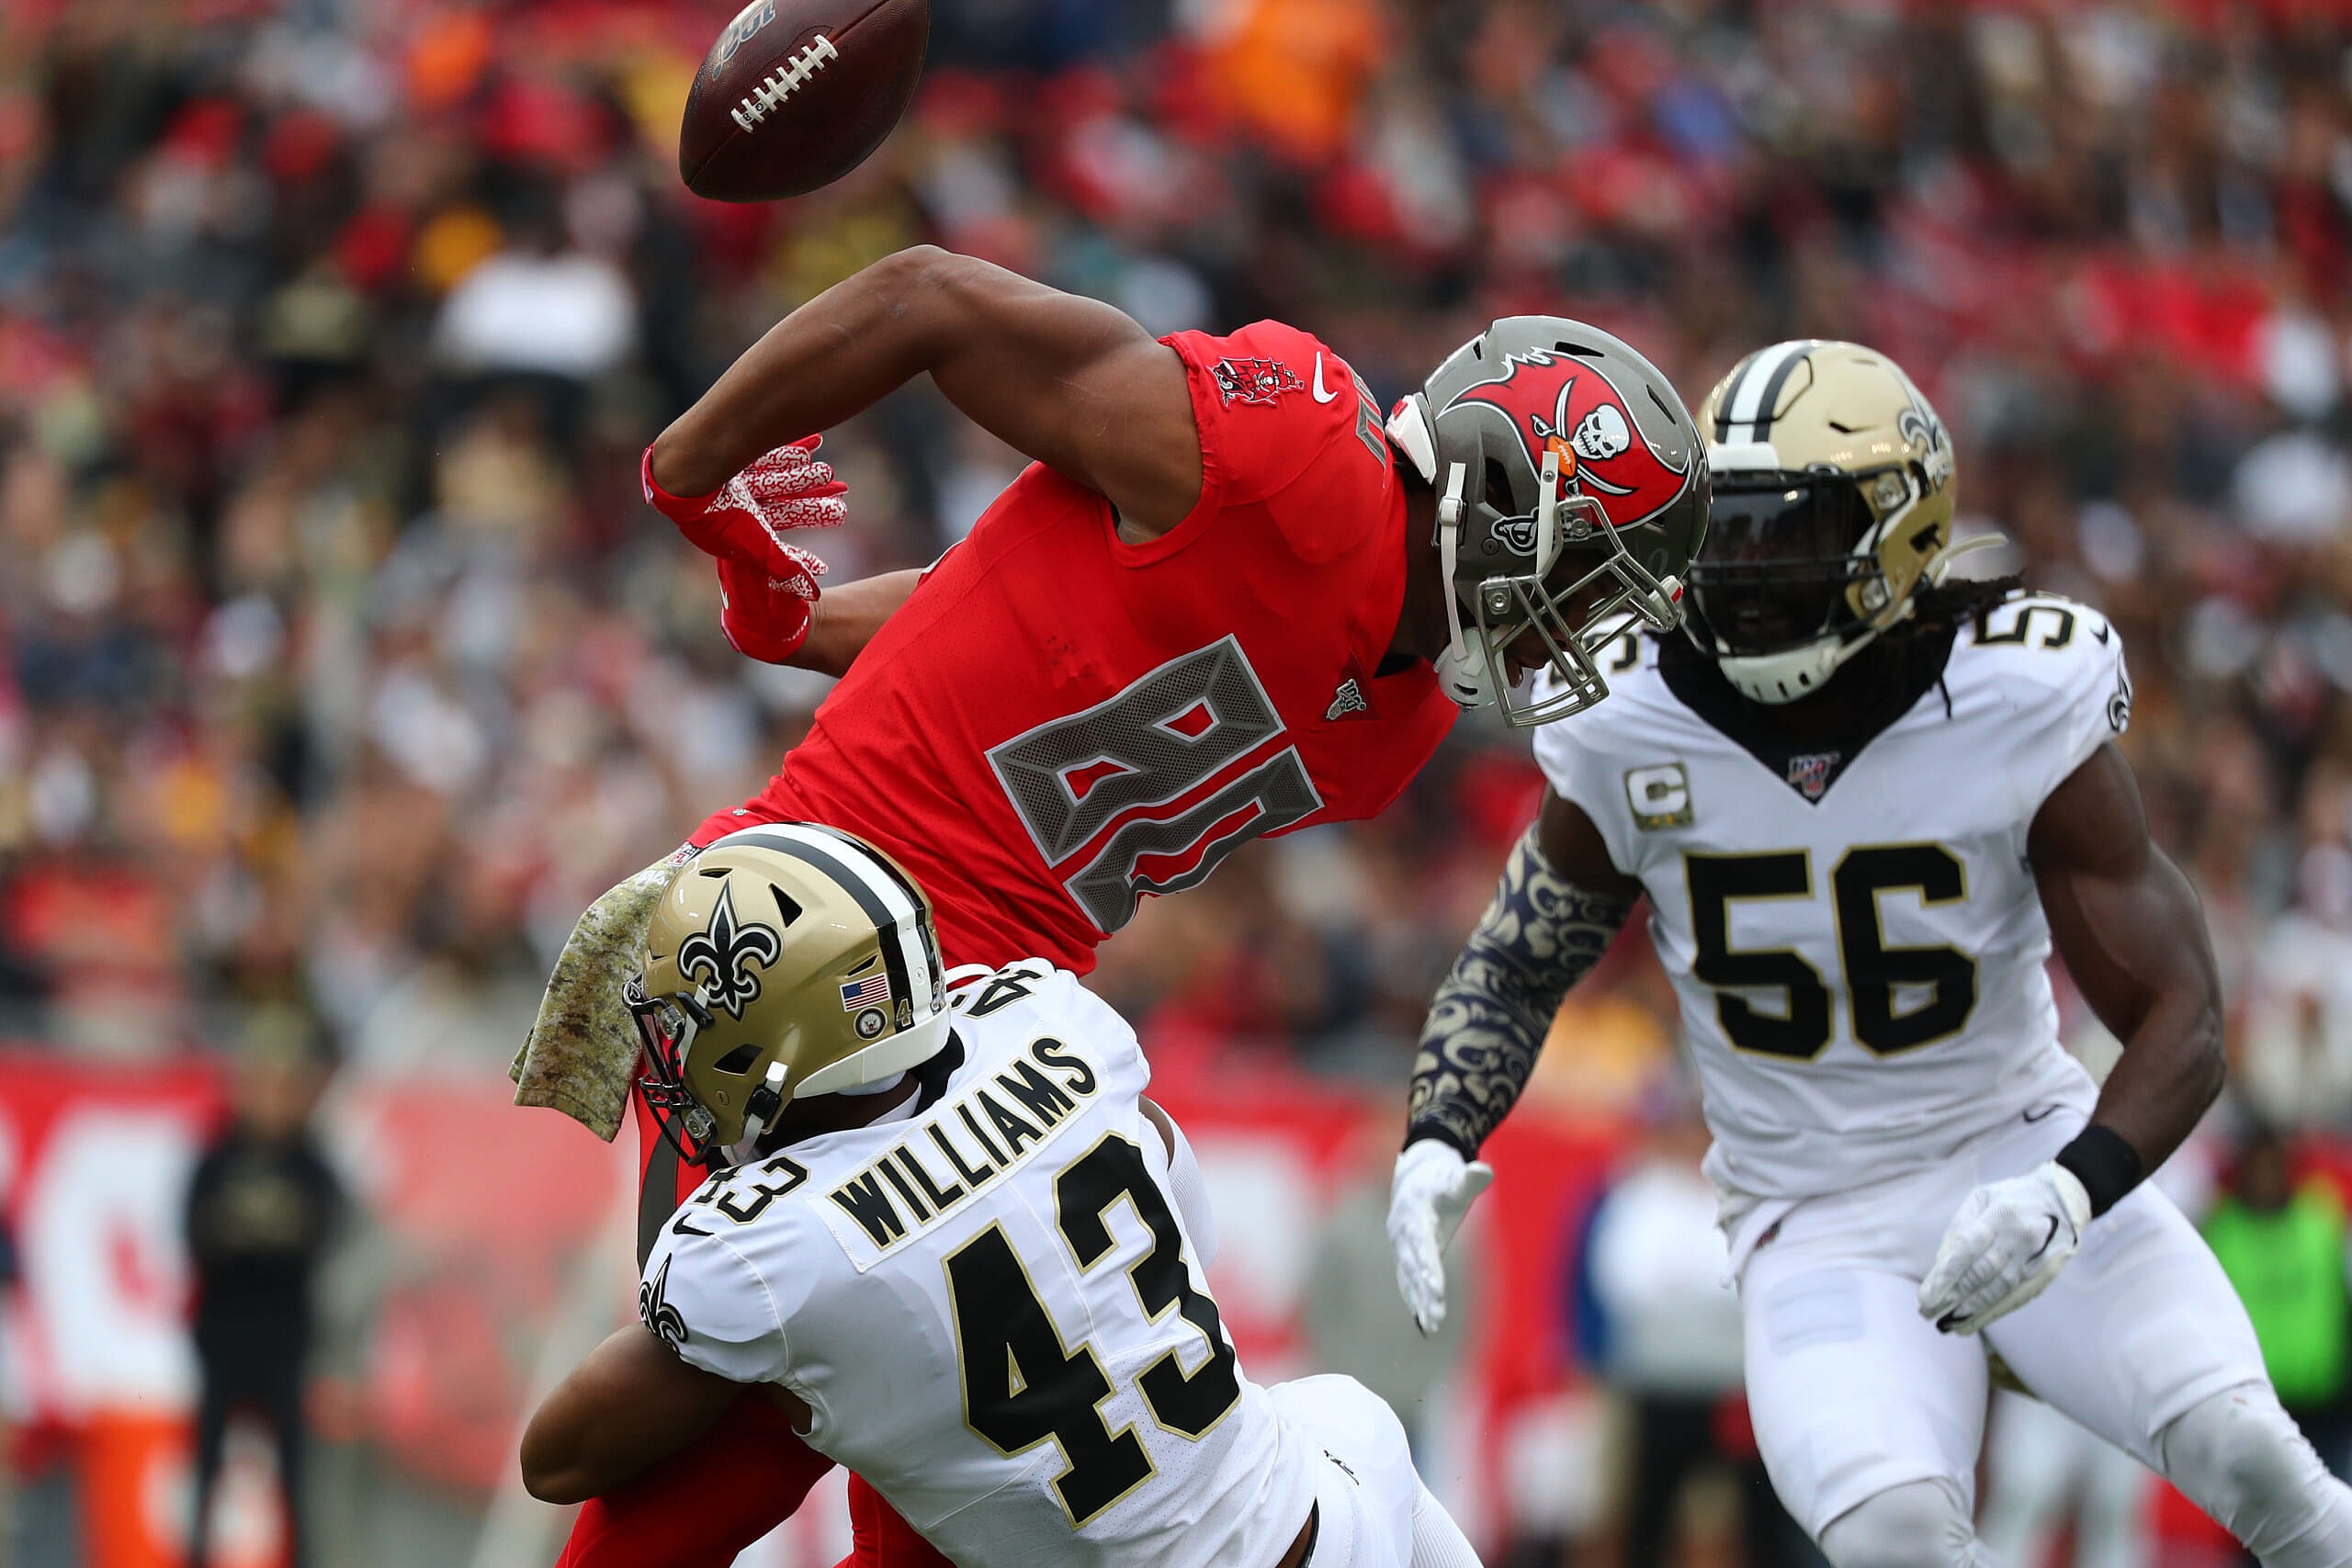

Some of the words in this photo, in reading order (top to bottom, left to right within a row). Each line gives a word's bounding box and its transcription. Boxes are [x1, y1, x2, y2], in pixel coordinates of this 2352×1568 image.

[1969, 587, 2076, 651] 5
[984, 633, 1325, 933] 80
[1627, 766, 1687, 816] C
[1680, 840, 1979, 1064] 56
[825, 1035, 1099, 1252] WILLIAMS
[941, 1129, 1243, 1531] 43
